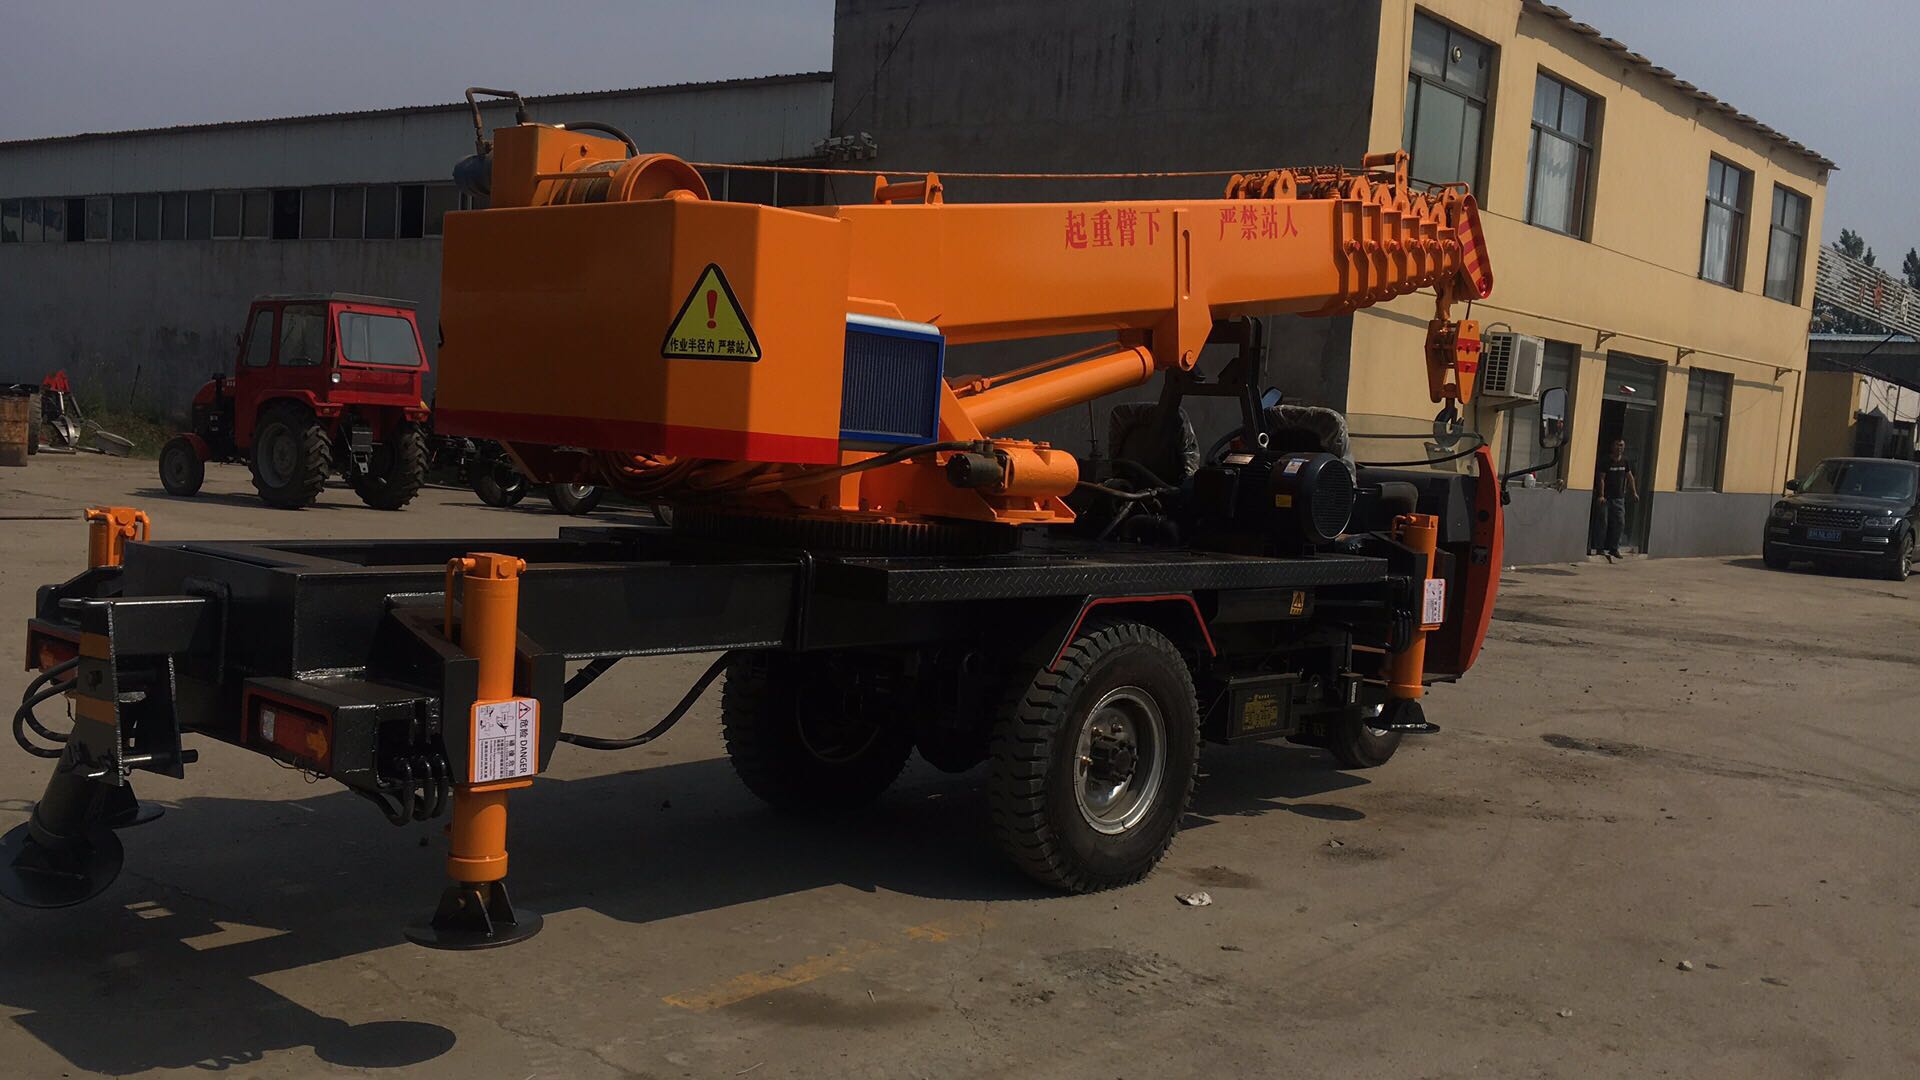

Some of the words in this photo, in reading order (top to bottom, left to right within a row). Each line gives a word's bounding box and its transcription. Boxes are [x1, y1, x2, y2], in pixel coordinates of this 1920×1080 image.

[1065, 208, 1161, 249] 起重臂下
[1219, 205, 1298, 241] 严禁站人
[671, 338, 715, 353] 作业半径内
[718, 339, 753, 355] 严禁站人
[520, 719, 528, 738] 危险
[520, 740, 528, 773] DANGER
